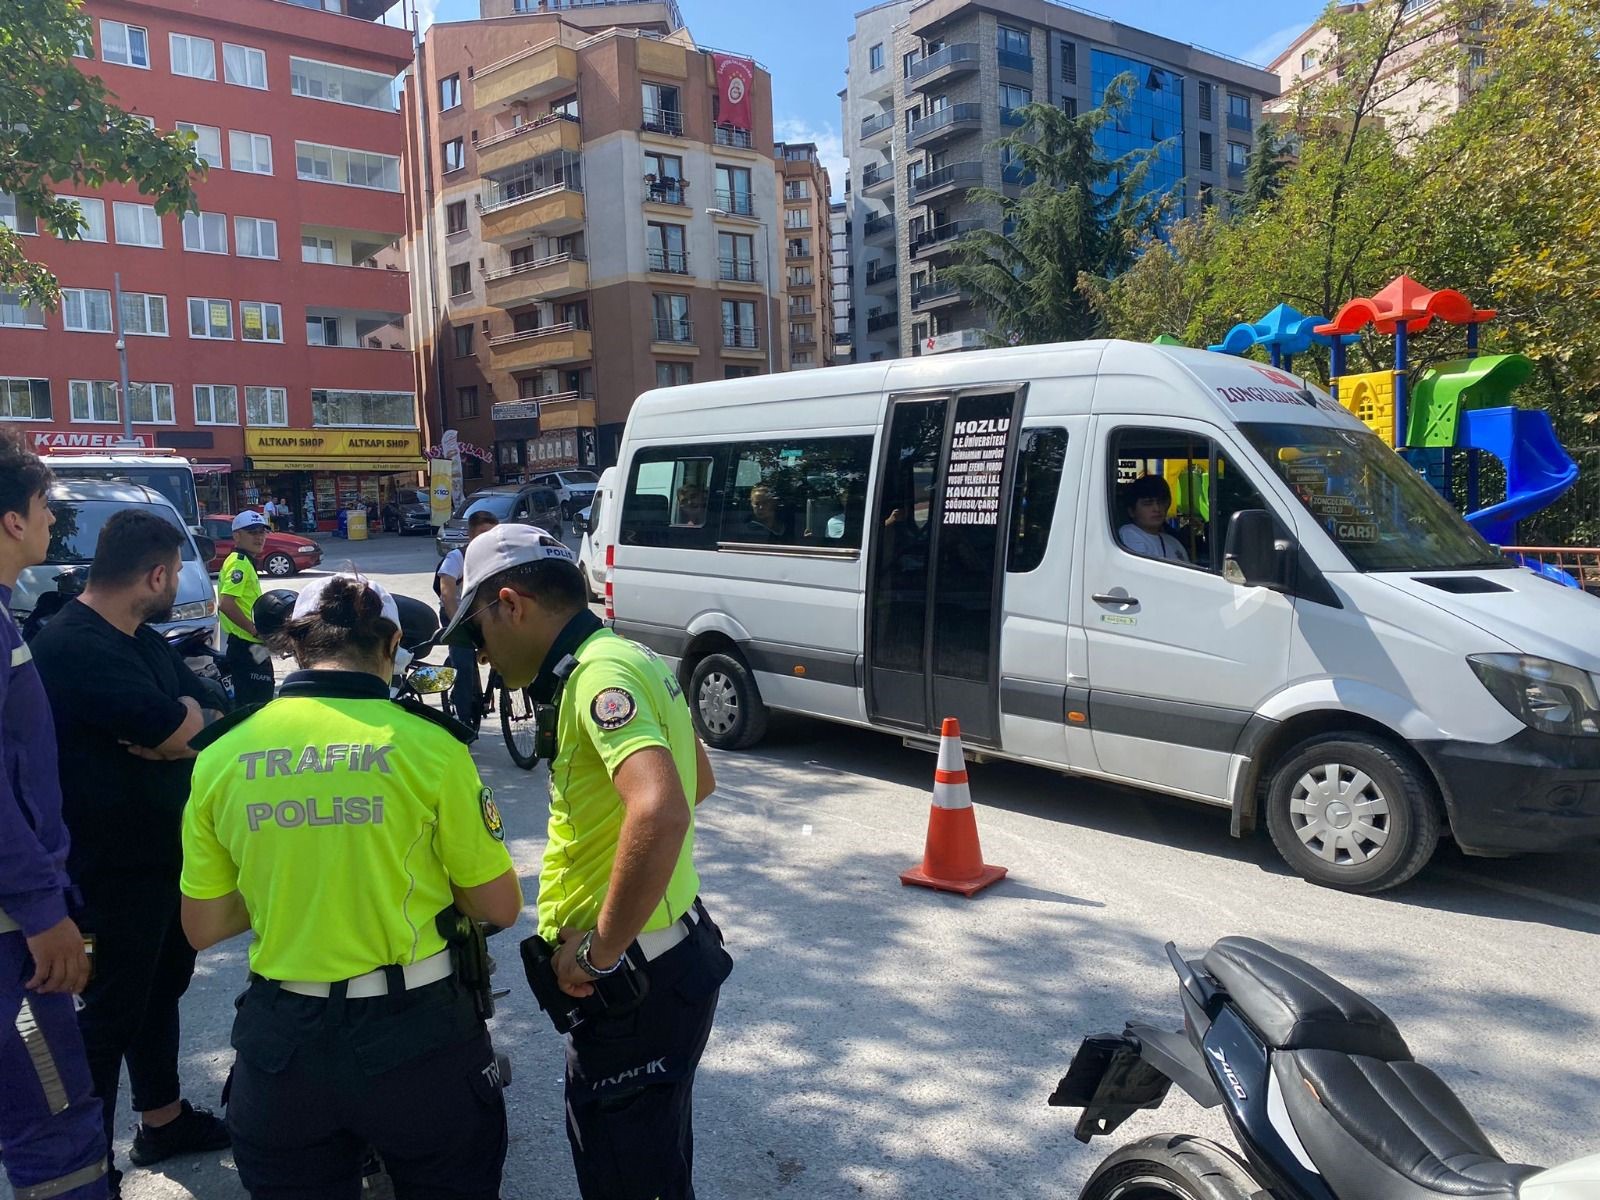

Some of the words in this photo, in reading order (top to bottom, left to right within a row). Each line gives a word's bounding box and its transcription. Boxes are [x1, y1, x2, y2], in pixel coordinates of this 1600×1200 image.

[954, 418, 1010, 434] KOZLU
[34, 433, 146, 447] KAMELA
[258, 437, 298, 447] ALTKAPI
[299, 438, 324, 447] SHOP
[348, 438, 385, 448] ALTKAPI
[386, 439, 410, 448] SHOP
[946, 486, 1000, 498] KAVAKLIK
[943, 511, 998, 525] ZONGULDAK
